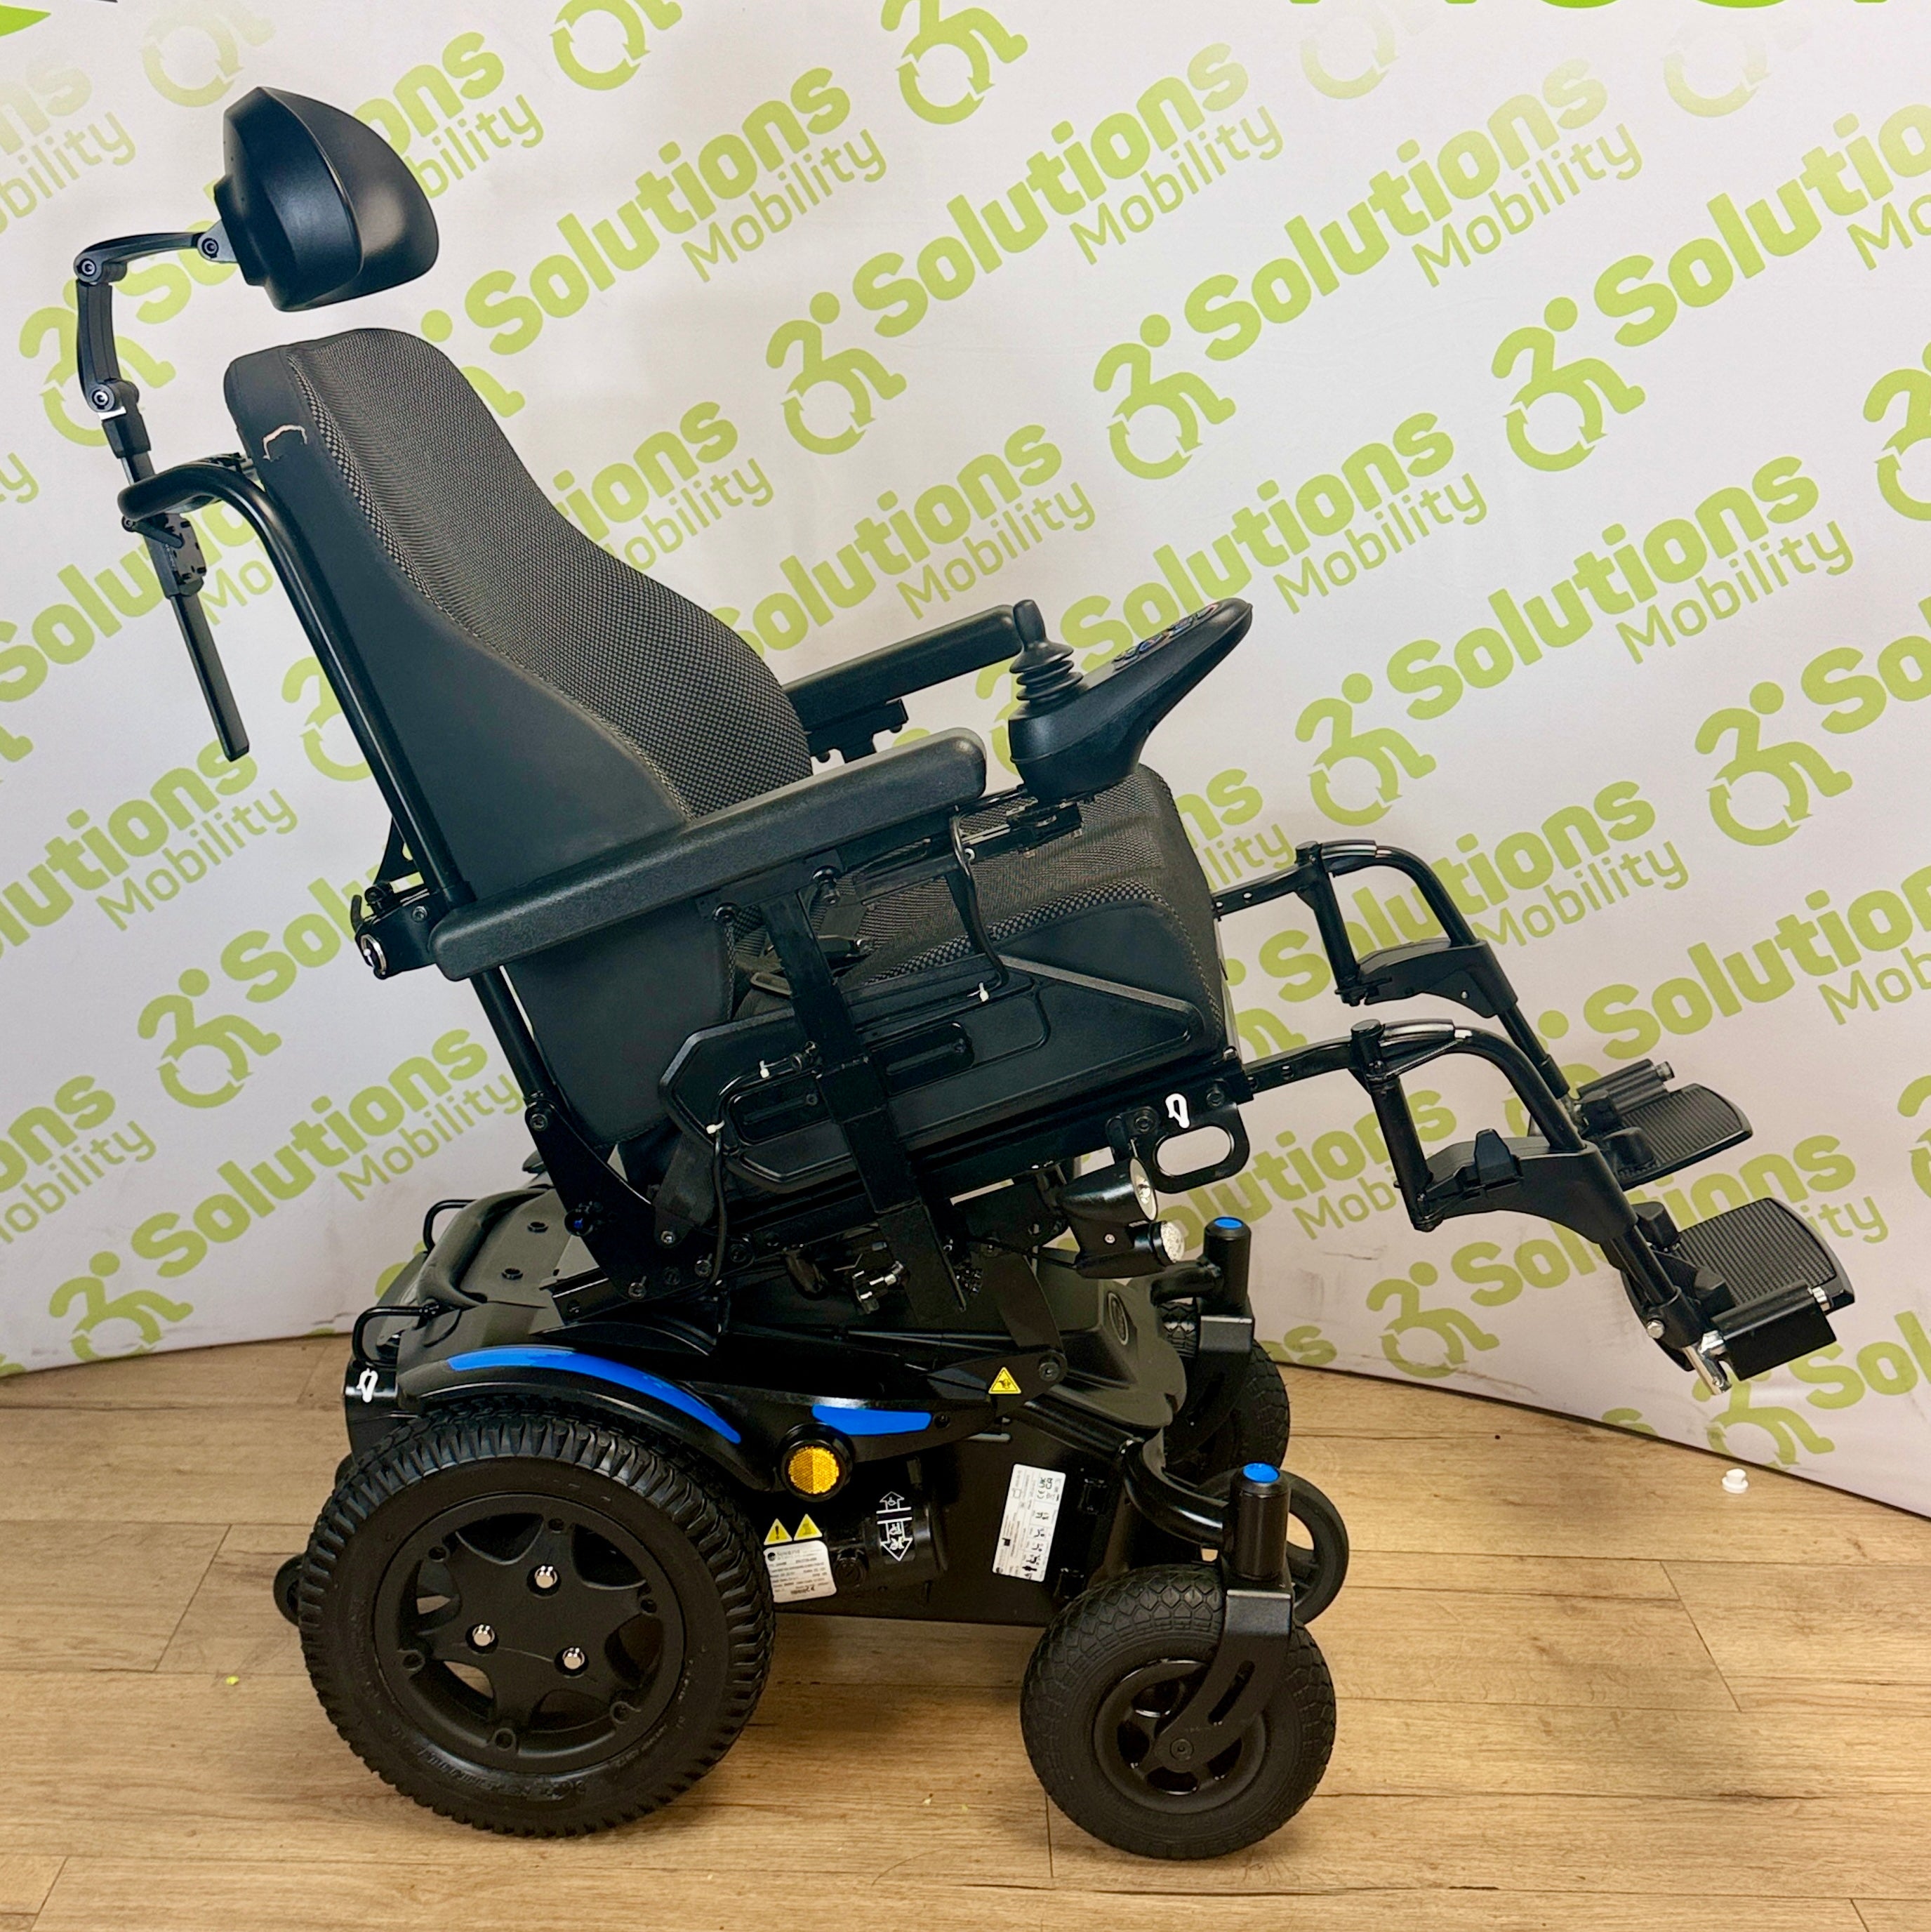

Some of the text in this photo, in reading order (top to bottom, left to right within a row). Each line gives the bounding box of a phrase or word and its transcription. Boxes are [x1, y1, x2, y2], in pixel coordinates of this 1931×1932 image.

[465, 67, 850, 355] Solutions
[681, 128, 887, 283] Mobility
[852, 42, 1249, 338] Solutions
[1069, 106, 1283, 265] Mobility
[1184, 58, 1607, 362] Solutions
[1411, 124, 1642, 288] Mobility
[1594, 104, 1931, 347] Solutio
[602, 458, 774, 570] obility
[896, 482, 1096, 620] Mobility
[1060, 413, 1454, 672] Solutions
[1273, 473, 1487, 614] Mobility
[1386, 456, 1819, 720] Solutions
[1615, 521, 1853, 664] Mobility
[96, 788, 298, 932] Mobility
[1472, 840, 1688, 948] Mobility
[0, 1120, 157, 1243] obility
[131, 1029, 488, 1278] Solutions
[337, 1074, 524, 1202] Mobility
